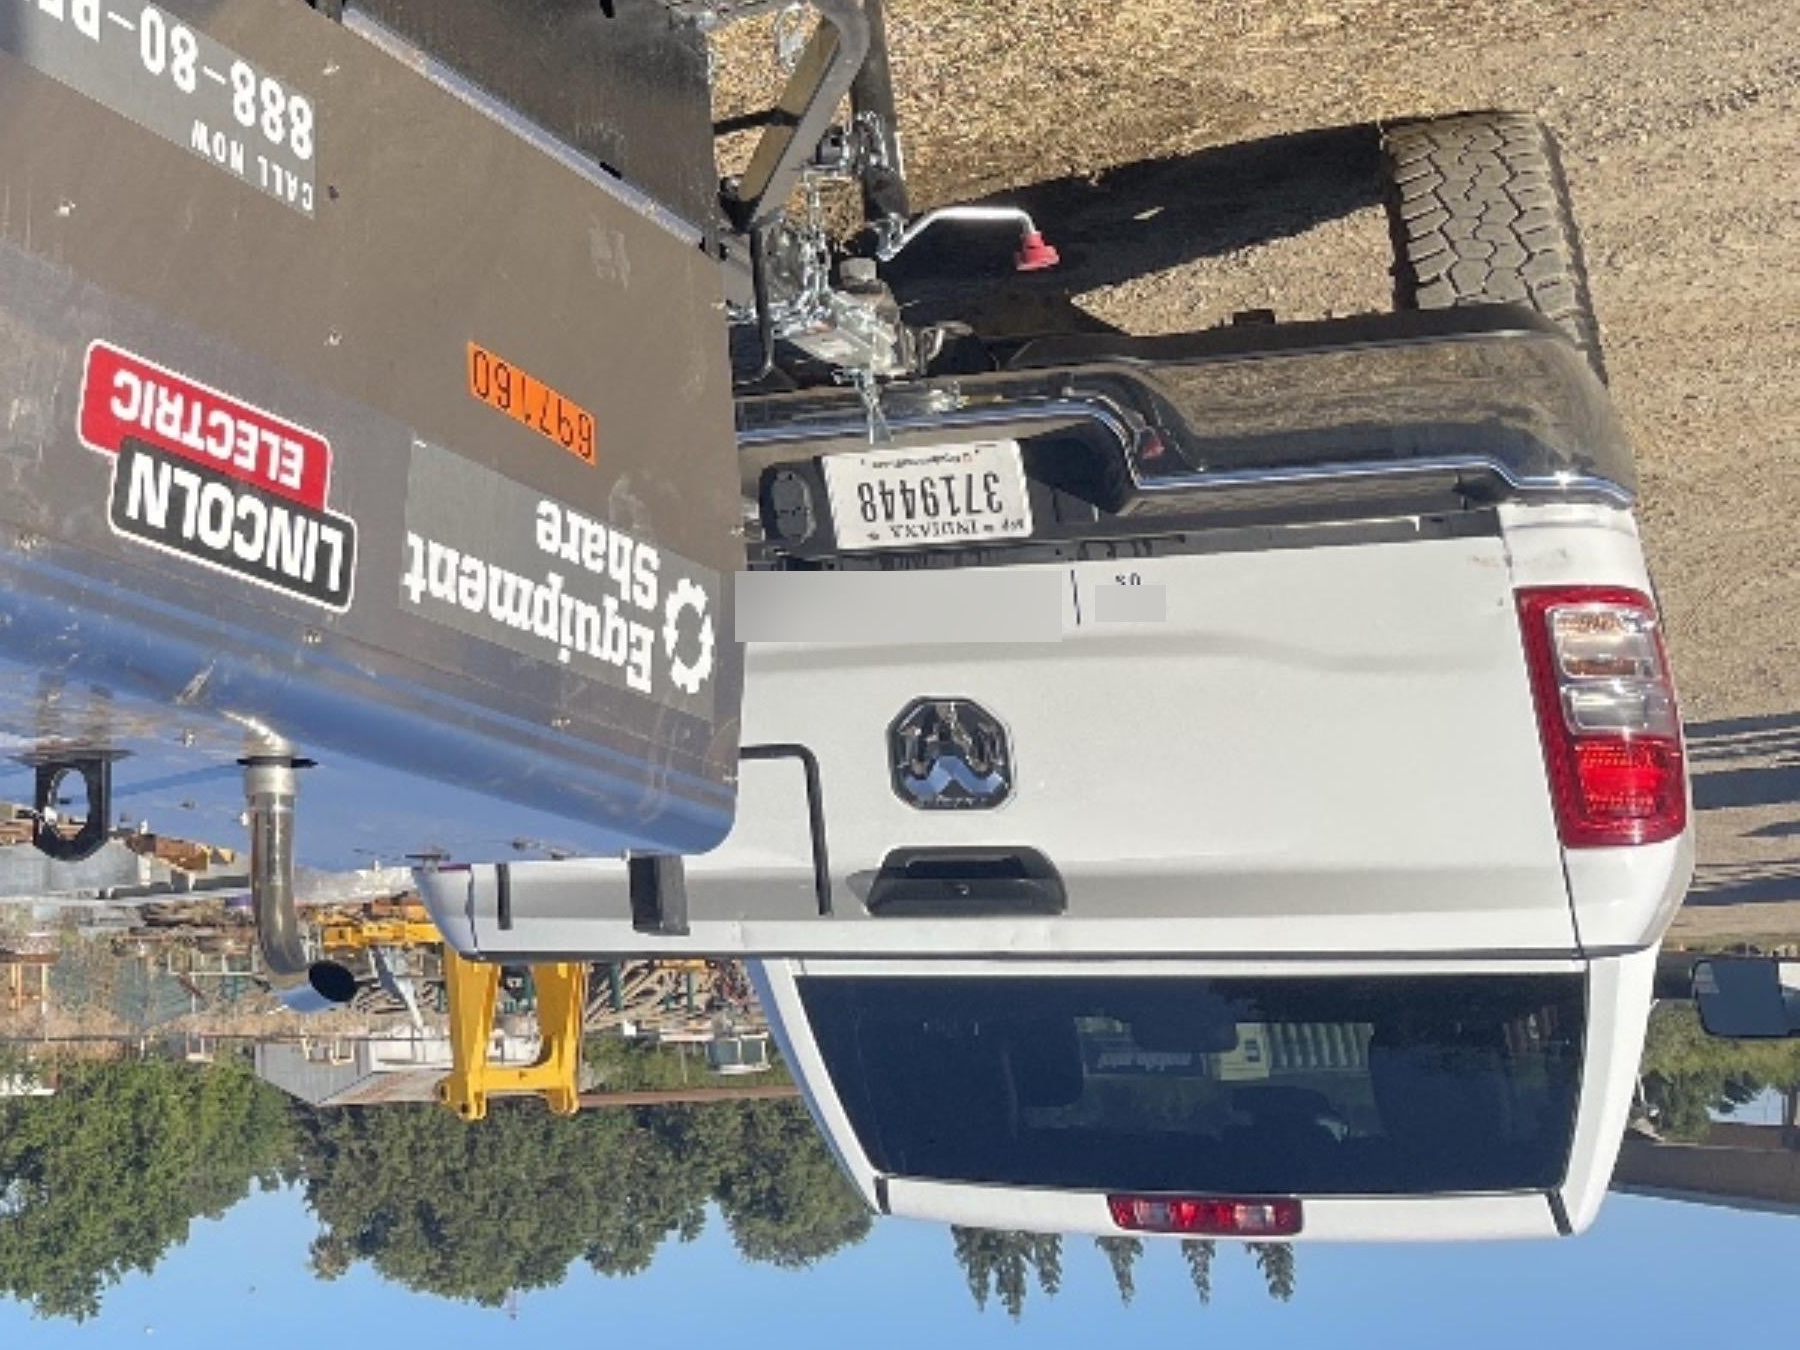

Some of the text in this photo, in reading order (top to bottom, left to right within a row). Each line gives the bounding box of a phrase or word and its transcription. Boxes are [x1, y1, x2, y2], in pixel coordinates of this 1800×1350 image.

[189, 118, 314, 210] CALL NOW
[109, 368, 306, 487] ELECTRIC
[471, 349, 595, 460] 697160
[125, 449, 346, 593] LINCOLN
[855, 471, 1003, 524] 3719448
[533, 498, 662, 610] Share
[400, 529, 656, 694] Equipment
